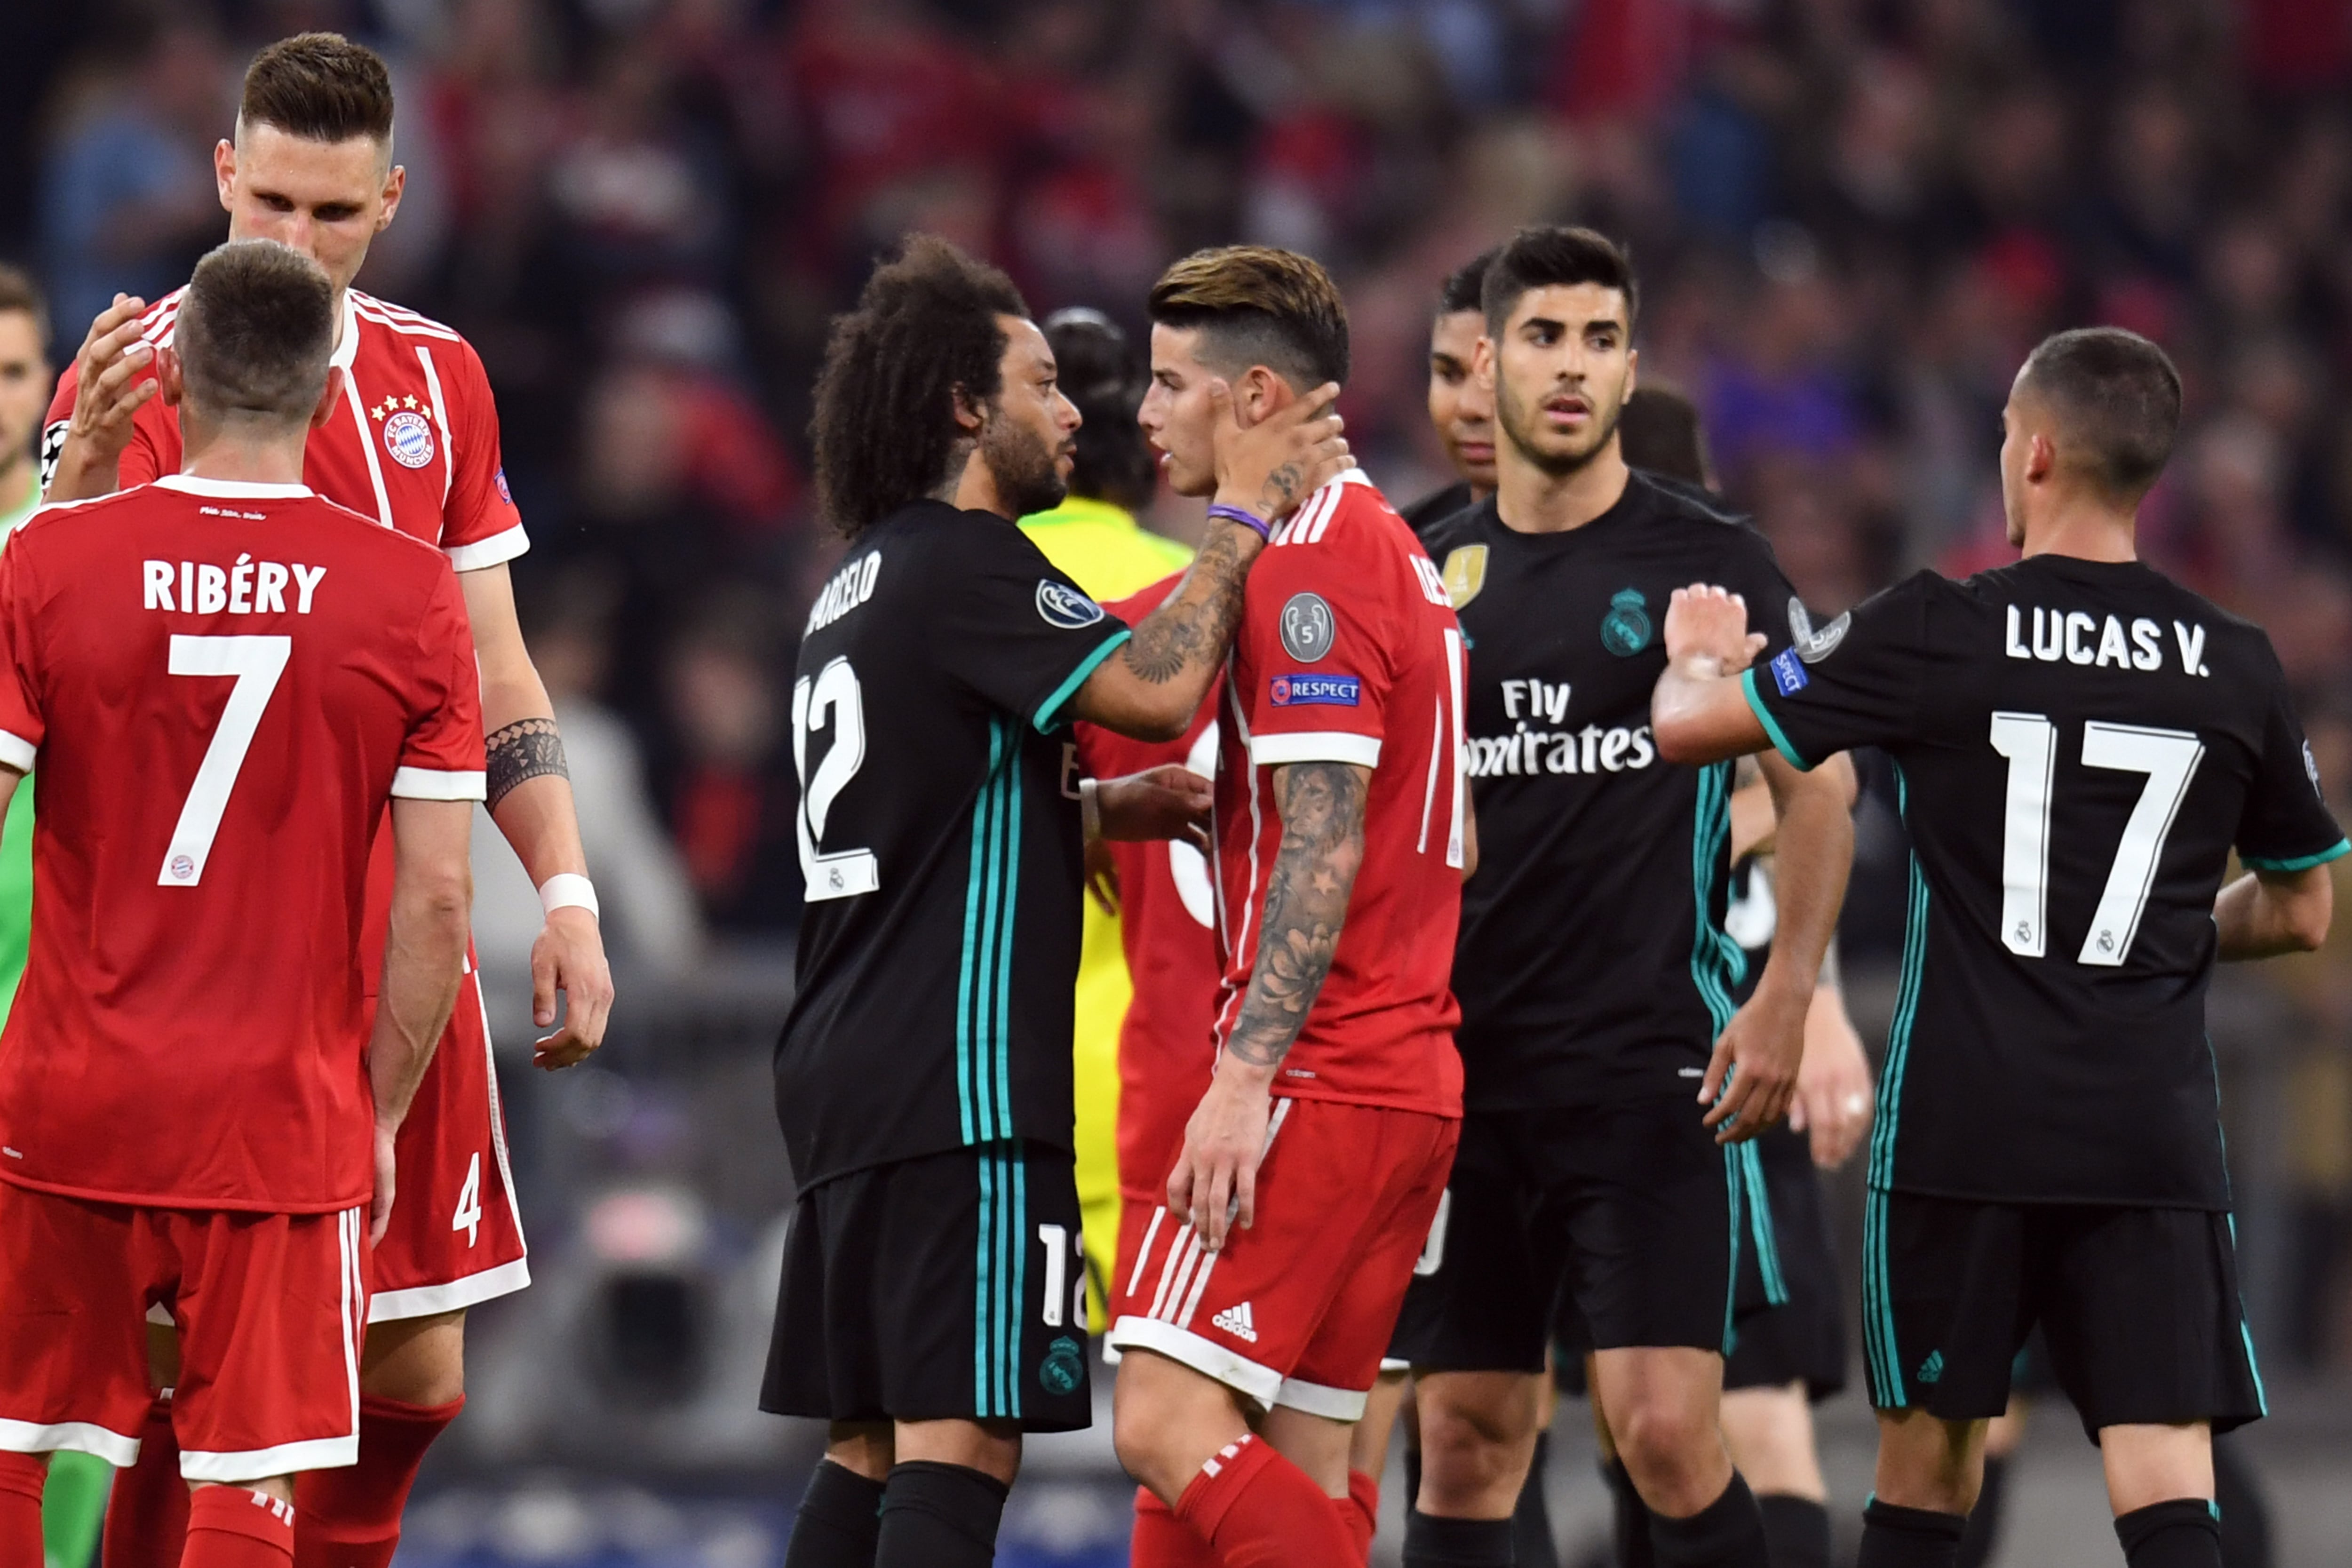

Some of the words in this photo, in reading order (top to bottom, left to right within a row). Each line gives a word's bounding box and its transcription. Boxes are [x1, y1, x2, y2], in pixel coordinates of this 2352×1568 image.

[387, 425, 397, 438] FC
[394, 416, 429, 436] BAYERN
[143, 552, 327, 614] RIBÉRY
[801, 549, 882, 644] ARCELO
[1301, 625, 1314, 644] 5
[2005, 604, 2162, 671] LUCAS
[2173, 619, 2210, 678] V.
[1292, 682, 1359, 699] RESPECT
[1500, 678, 1571, 724] Fly
[1775, 653, 1802, 692] SPECT
[157, 634, 292, 887] 7
[791, 654, 880, 902] 12
[1989, 710, 2206, 967] 17
[453, 1151, 482, 1249] 4
[1212, 1313, 1258, 1343] adidas
